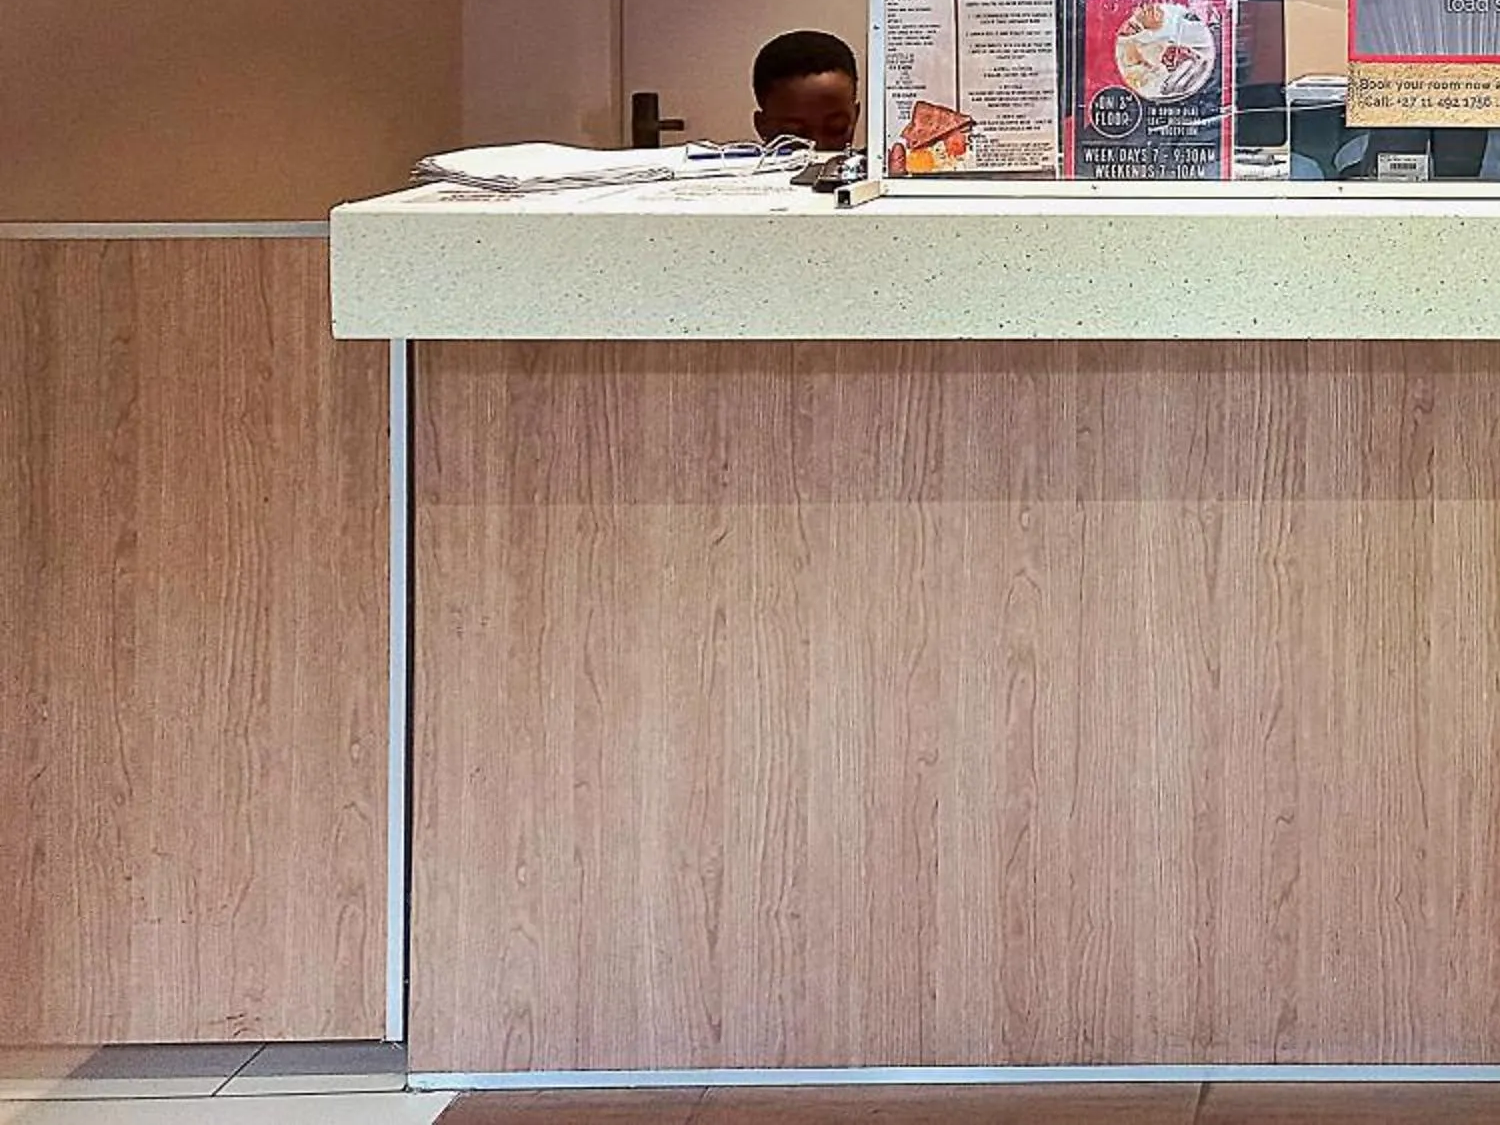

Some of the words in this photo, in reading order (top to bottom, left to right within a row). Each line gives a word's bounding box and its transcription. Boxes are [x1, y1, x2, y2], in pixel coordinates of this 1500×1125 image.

[1359, 78, 1391, 90] Book
[1395, 79, 1423, 92] your
[1427, 80, 1461, 91] room
[1465, 81, 1491, 91] now
[1095, 112, 1130, 126] FLOOR
[1084, 149, 1115, 162] WEEK
[1119, 149, 1147, 162] DAYS
[1095, 165, 1155, 178] WEEKENDS
